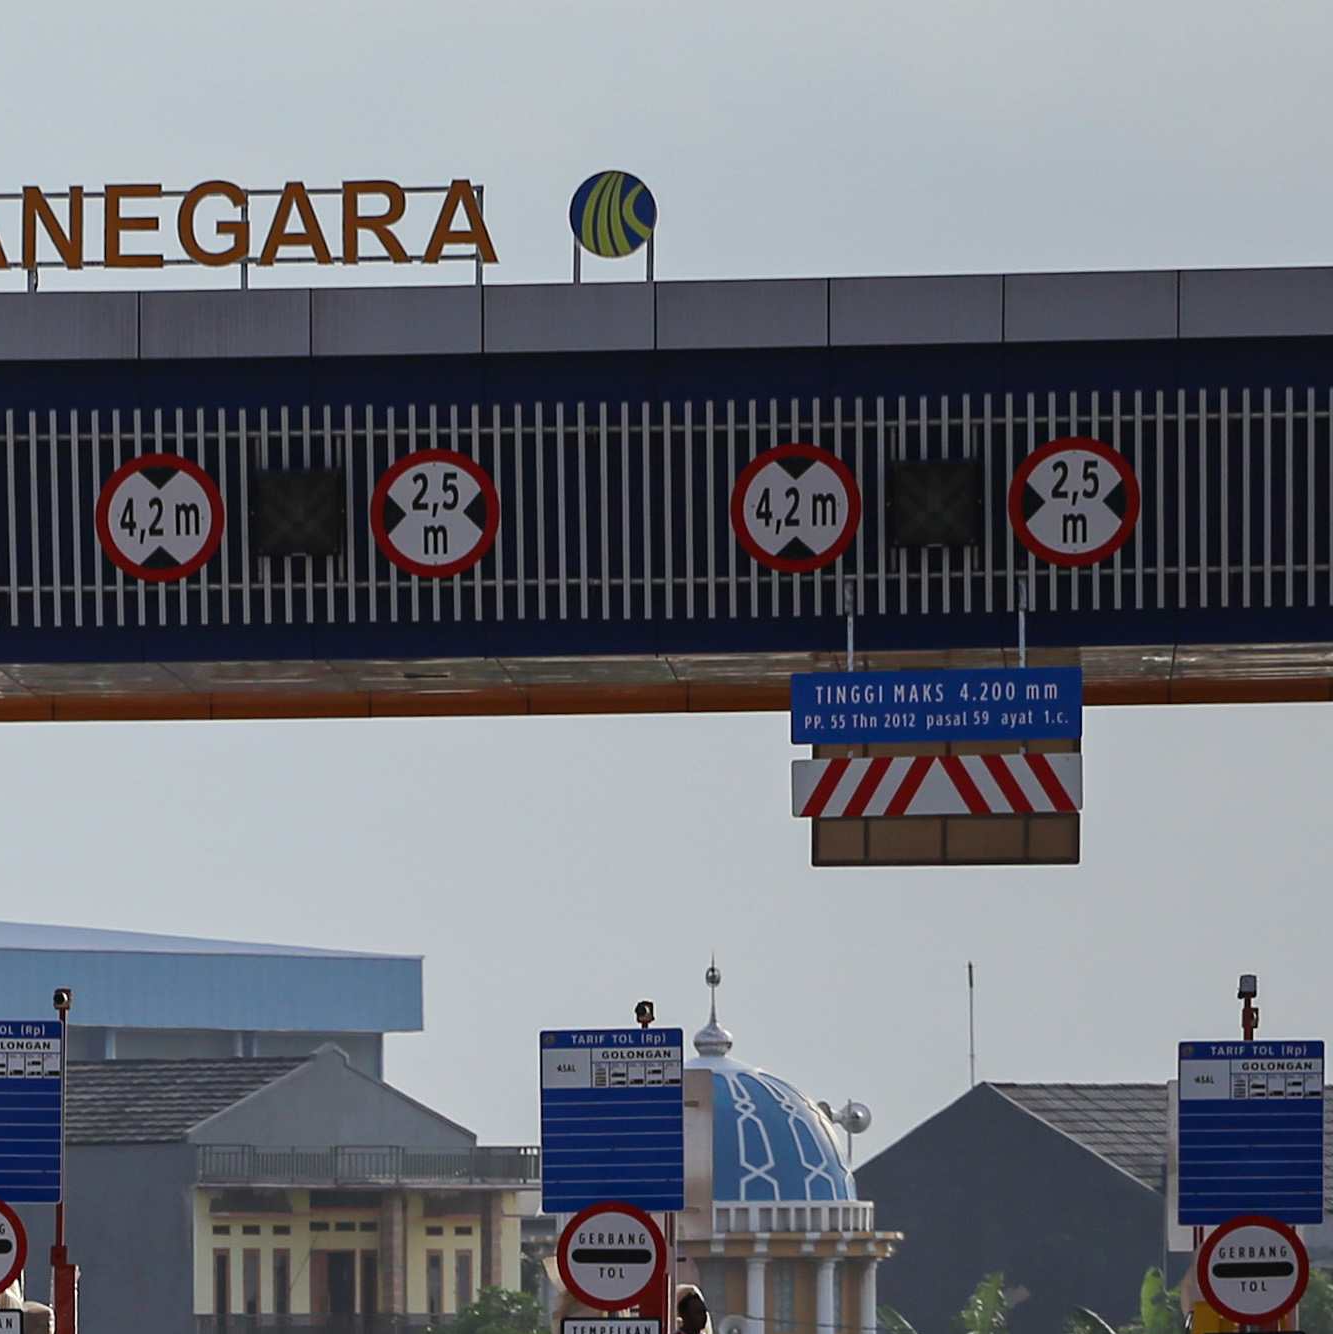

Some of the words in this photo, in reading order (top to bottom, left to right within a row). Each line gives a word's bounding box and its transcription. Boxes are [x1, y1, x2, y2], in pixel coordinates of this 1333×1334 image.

[1049, 459, 1101, 507] 2,5
[410, 471, 460, 519] 2,5
[754, 486, 802, 536] 4,2
[810, 492, 838, 527] m
[118, 496, 165, 545] 4,2
[173, 502, 202, 537] m
[1060, 512, 1089, 545] m
[422, 524, 449, 556] m
[816, 686, 883, 704] TINGGI
[894, 684, 944, 703] MAKS
[960, 682, 1015, 701] 4.200
[1026, 683, 1058, 700] mm
[804, 715, 825, 730] PP.
[830, 714, 847, 730] 55
[852, 714, 878, 729] Thn
[883, 713, 917, 728] 2012
[927, 712, 967, 730] pasal
[972, 710, 990, 726] 59
[1001, 711, 1033, 729] ayat
[19, 1024, 47, 1037] (Rp)
[570, 1033, 606, 1045] TARIF
[611, 1033, 635, 1045] TOL
[640, 1032, 667, 1046] (Rp)
[601, 1049, 673, 1060] GOLONGAN
[1209, 1045, 1246, 1056] TARIF
[1251, 1045, 1276, 1056] TOL
[1280, 1045, 1308, 1057] (Rp)
[1241, 1061, 1314, 1071] GOLONGAN
[578, 1232, 647, 1246] GERBANG
[1218, 1246, 1288, 1260] GERBANG
[598, 1266, 626, 1280] TOL
[1239, 1280, 1268, 1293] TOL
